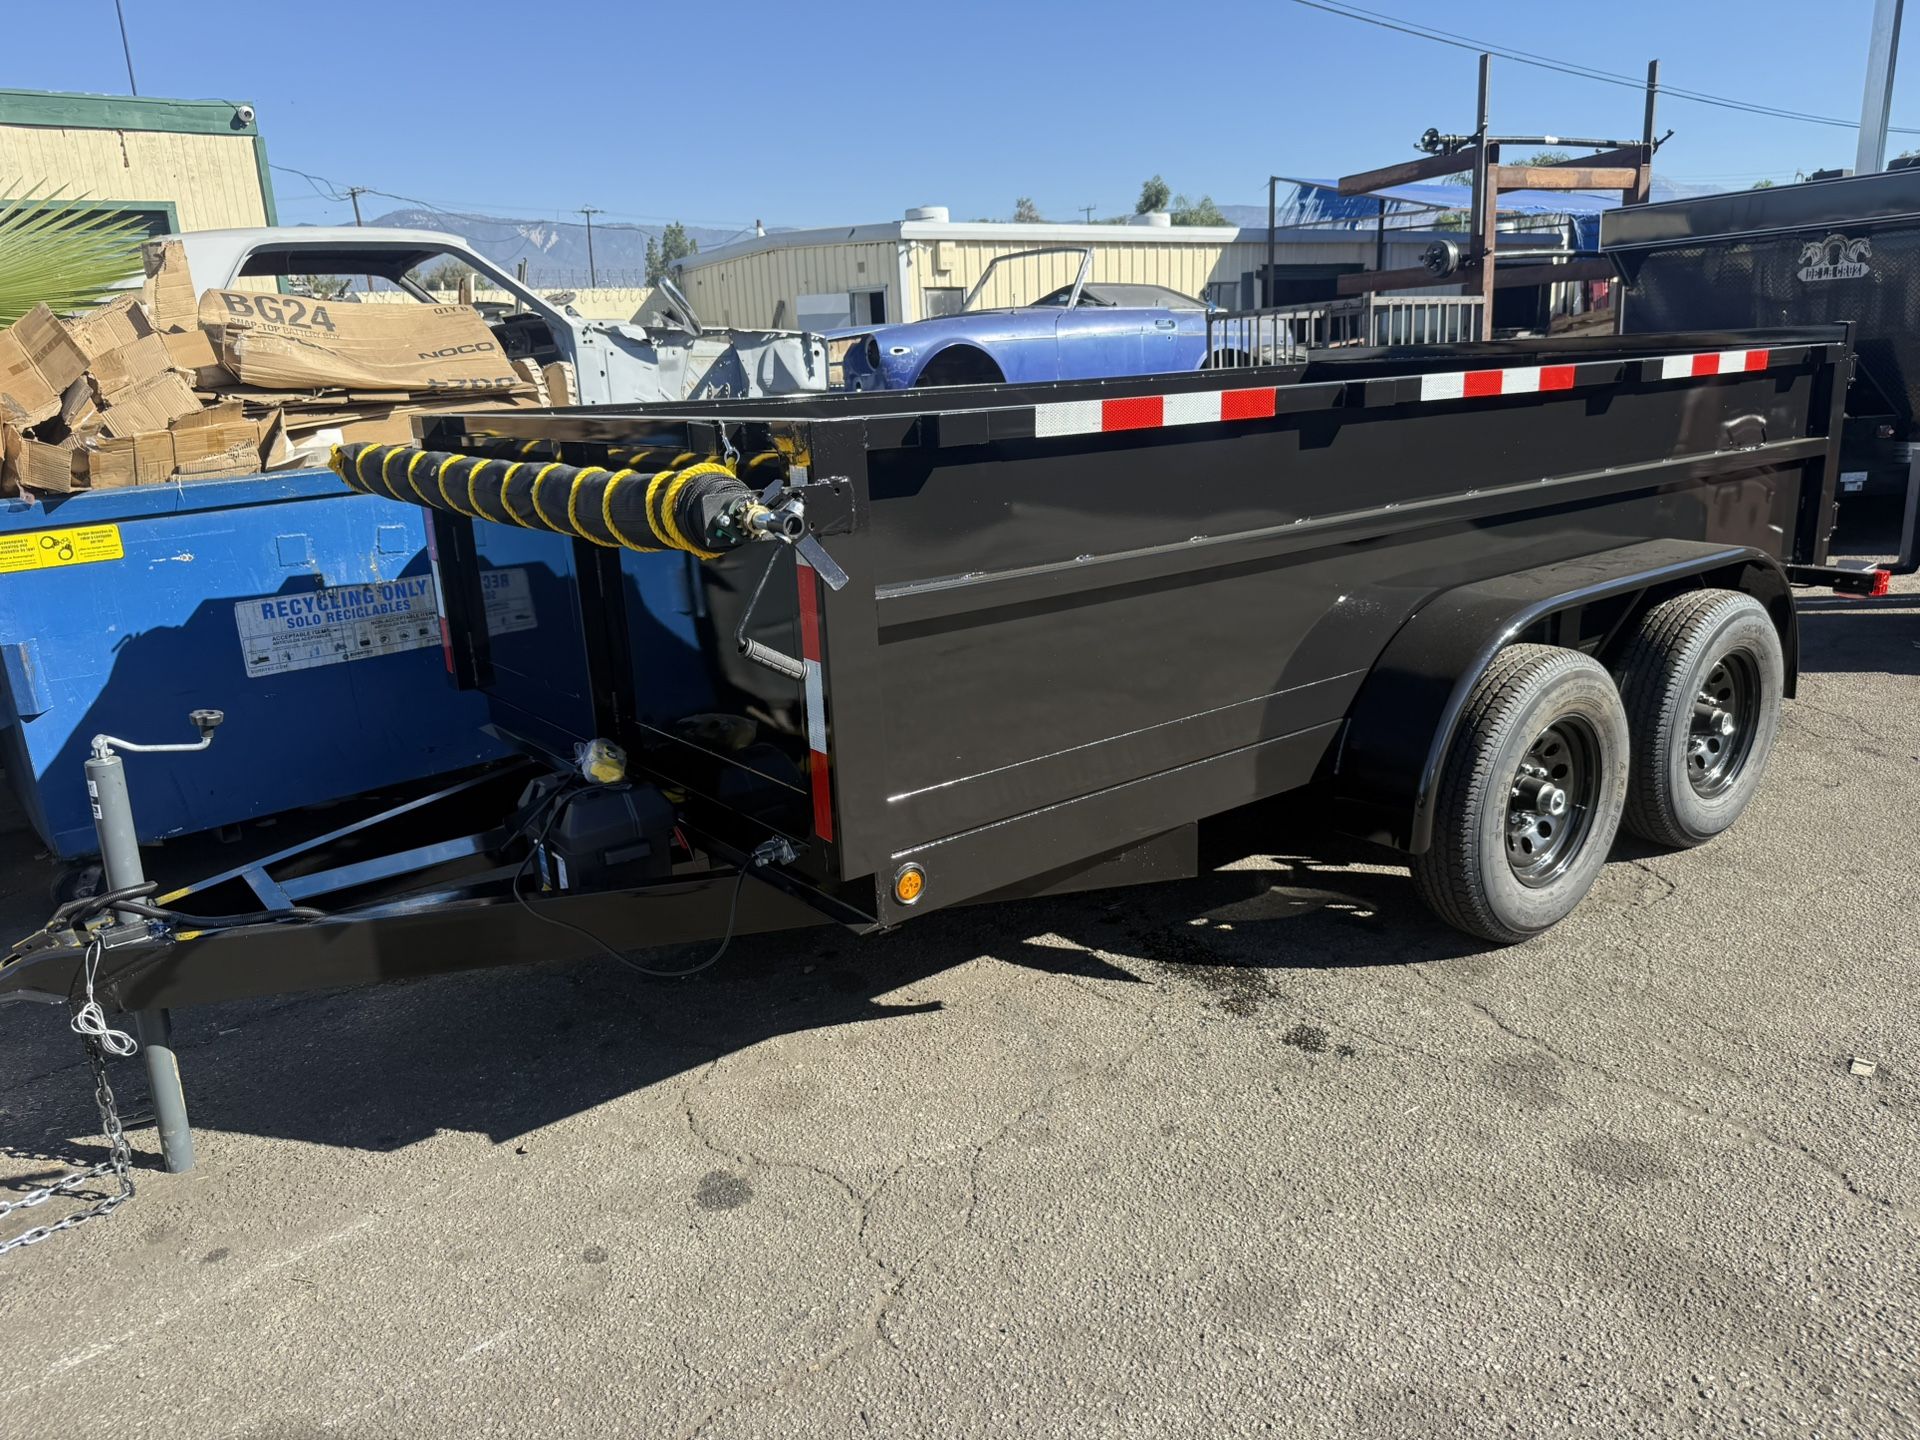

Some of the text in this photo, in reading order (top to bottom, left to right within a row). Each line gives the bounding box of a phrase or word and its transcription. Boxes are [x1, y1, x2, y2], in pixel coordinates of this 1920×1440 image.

[220, 292, 336, 332] BG24
[433, 306, 456, 315] QTY
[230, 317, 280, 333] SNAP-TOP
[418, 342, 495, 359] NOCO
[261, 580, 427, 619] RECYCLING ONLY
[286, 616, 321, 629] SOLO
